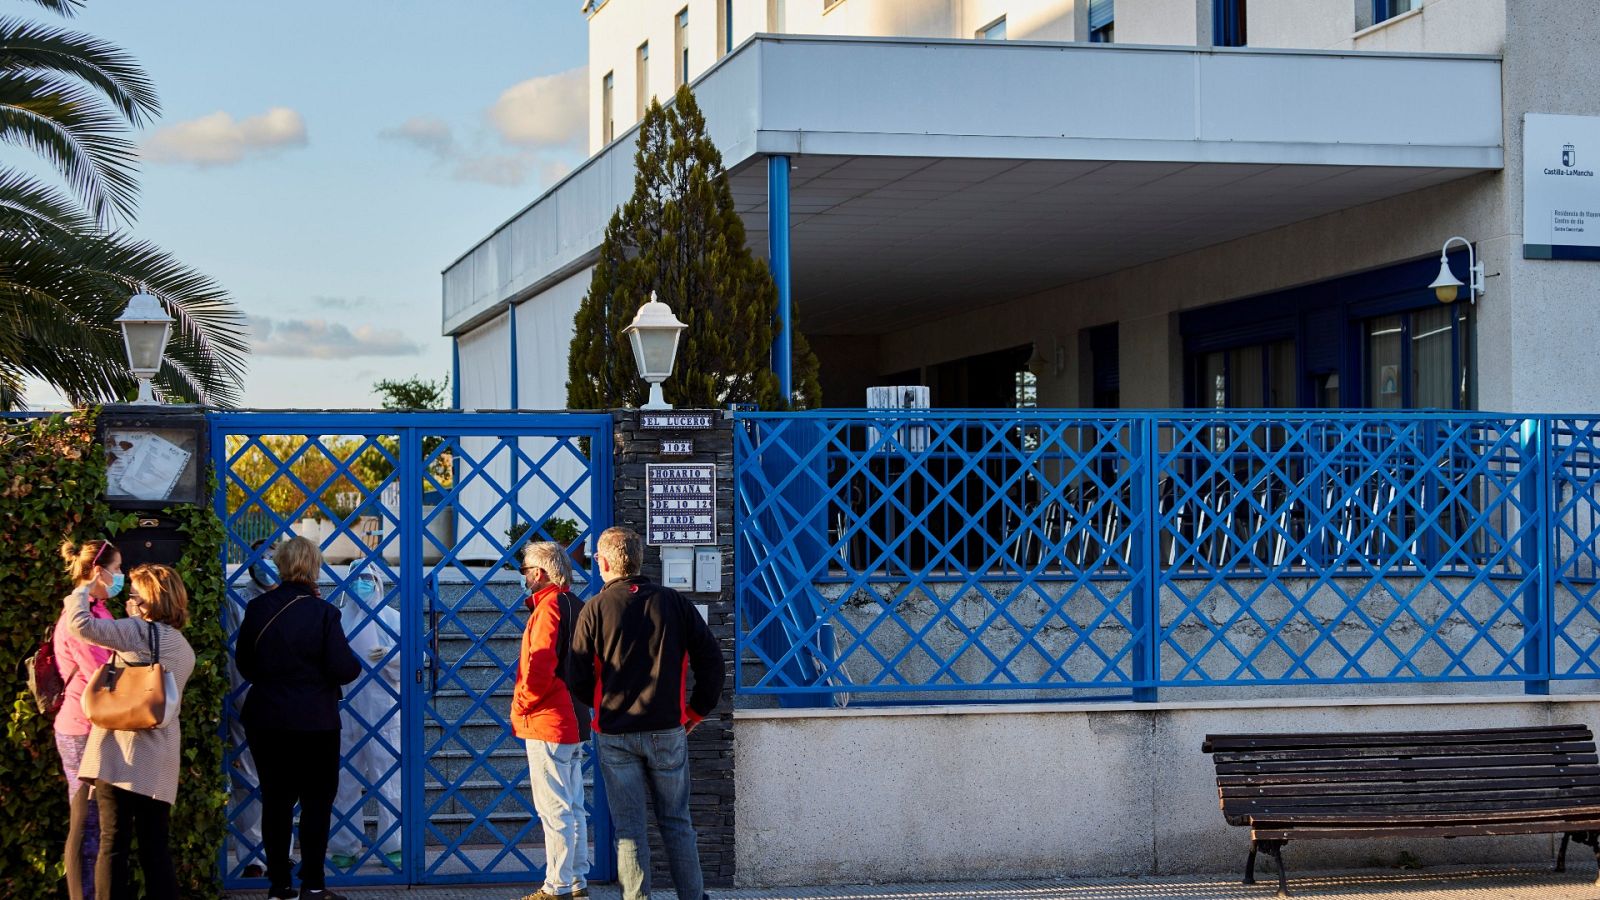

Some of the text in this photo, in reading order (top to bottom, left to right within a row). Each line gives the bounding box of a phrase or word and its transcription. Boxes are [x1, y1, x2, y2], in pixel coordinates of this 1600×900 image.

[647, 417, 706, 426] EL LUCERO
[668, 443, 686, 452] 102
[656, 469, 701, 478] HORARIO
[656, 500, 669, 508] DE
[677, 500, 688, 508] 10
[663, 516, 695, 524] TARDE
[663, 532, 676, 540] DE
[696, 531, 701, 539] 7
